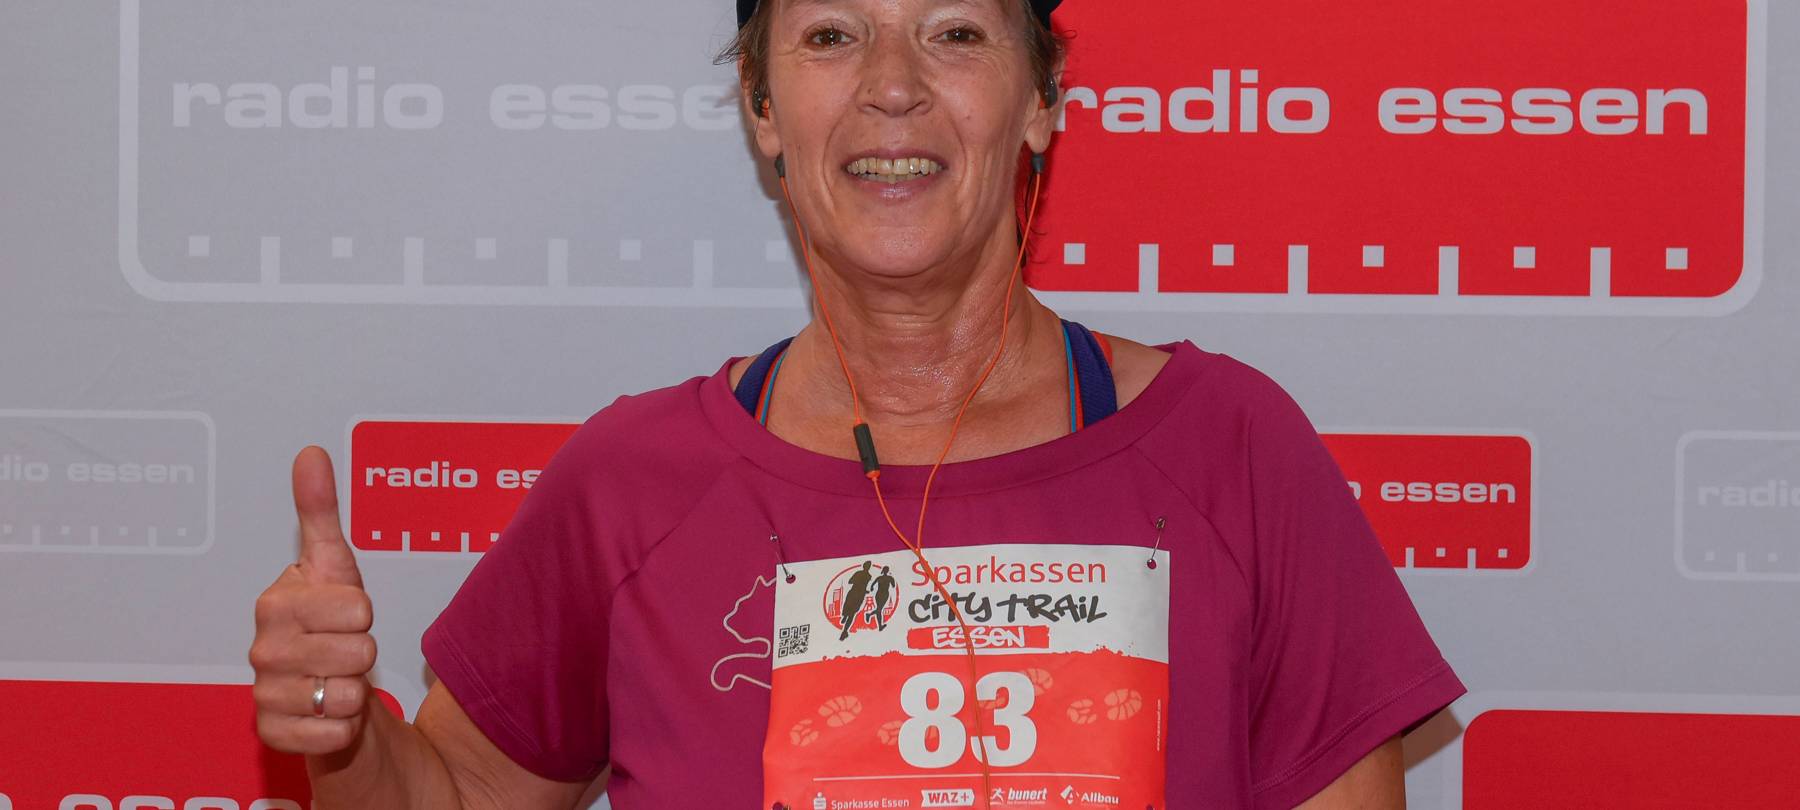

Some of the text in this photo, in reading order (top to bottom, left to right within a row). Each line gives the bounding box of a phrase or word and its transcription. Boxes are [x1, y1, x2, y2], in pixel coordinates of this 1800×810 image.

[172, 66, 740, 131] radio esse
[1057, 69, 1708, 135] radio essen
[67, 462, 194, 483] essen
[365, 461, 478, 487] radio
[1380, 481, 1516, 503] essen
[911, 556, 1106, 592] Sparkassen
[898, 671, 1038, 768] 83
[831, 797, 910, 810] Sparkasse Essen
[1008, 787, 1048, 801] bunert
[1080, 792, 1119, 804] Allbau
